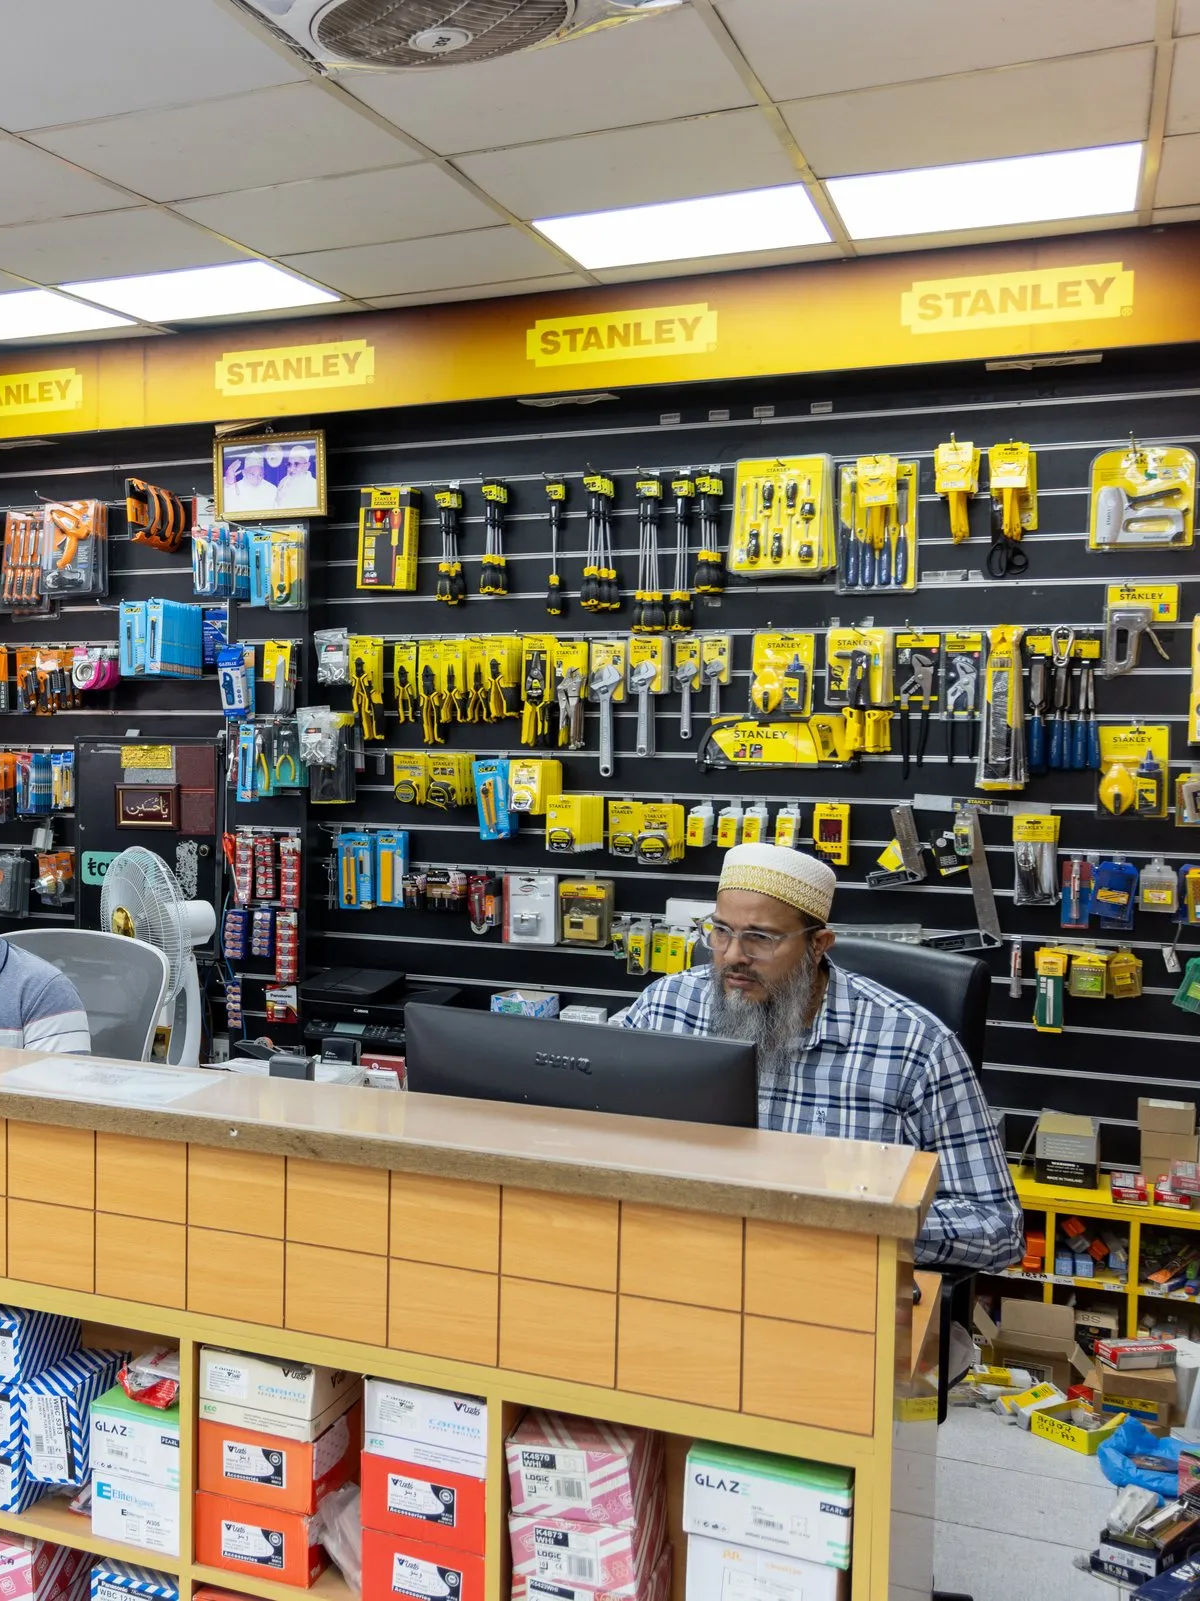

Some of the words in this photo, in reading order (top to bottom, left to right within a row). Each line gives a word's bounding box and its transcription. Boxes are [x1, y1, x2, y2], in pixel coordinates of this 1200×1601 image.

[917, 277, 1117, 320] STANLEY
[539, 316, 703, 356] STANLEY
[225, 351, 363, 388] STANLEY
[1120, 593, 1164, 601] STANLEY
[734, 729, 788, 739] STANLEY
[1112, 735, 1152, 744] STANLEY
[535, 1051, 592, 1075] BenQ
[55, 1415, 63, 1435] 5313
[161, 1438, 179, 1446] PEARL
[523, 1451, 550, 1461] K4870
[523, 1459, 541, 1468] WHI
[227, 1472, 259, 1482] Accessories
[390, 1506, 427, 1520] Accessories
[820, 1503, 845, 1515] PEARL
[535, 1528, 563, 1539] K4873
[536, 1536, 554, 1545] WHI
[224, 1551, 258, 1563] Accessories
[101, 1580, 128, 1593] Panasonic
[99, 1588, 118, 1600] WBC
[394, 1586, 431, 1601] Accessories
